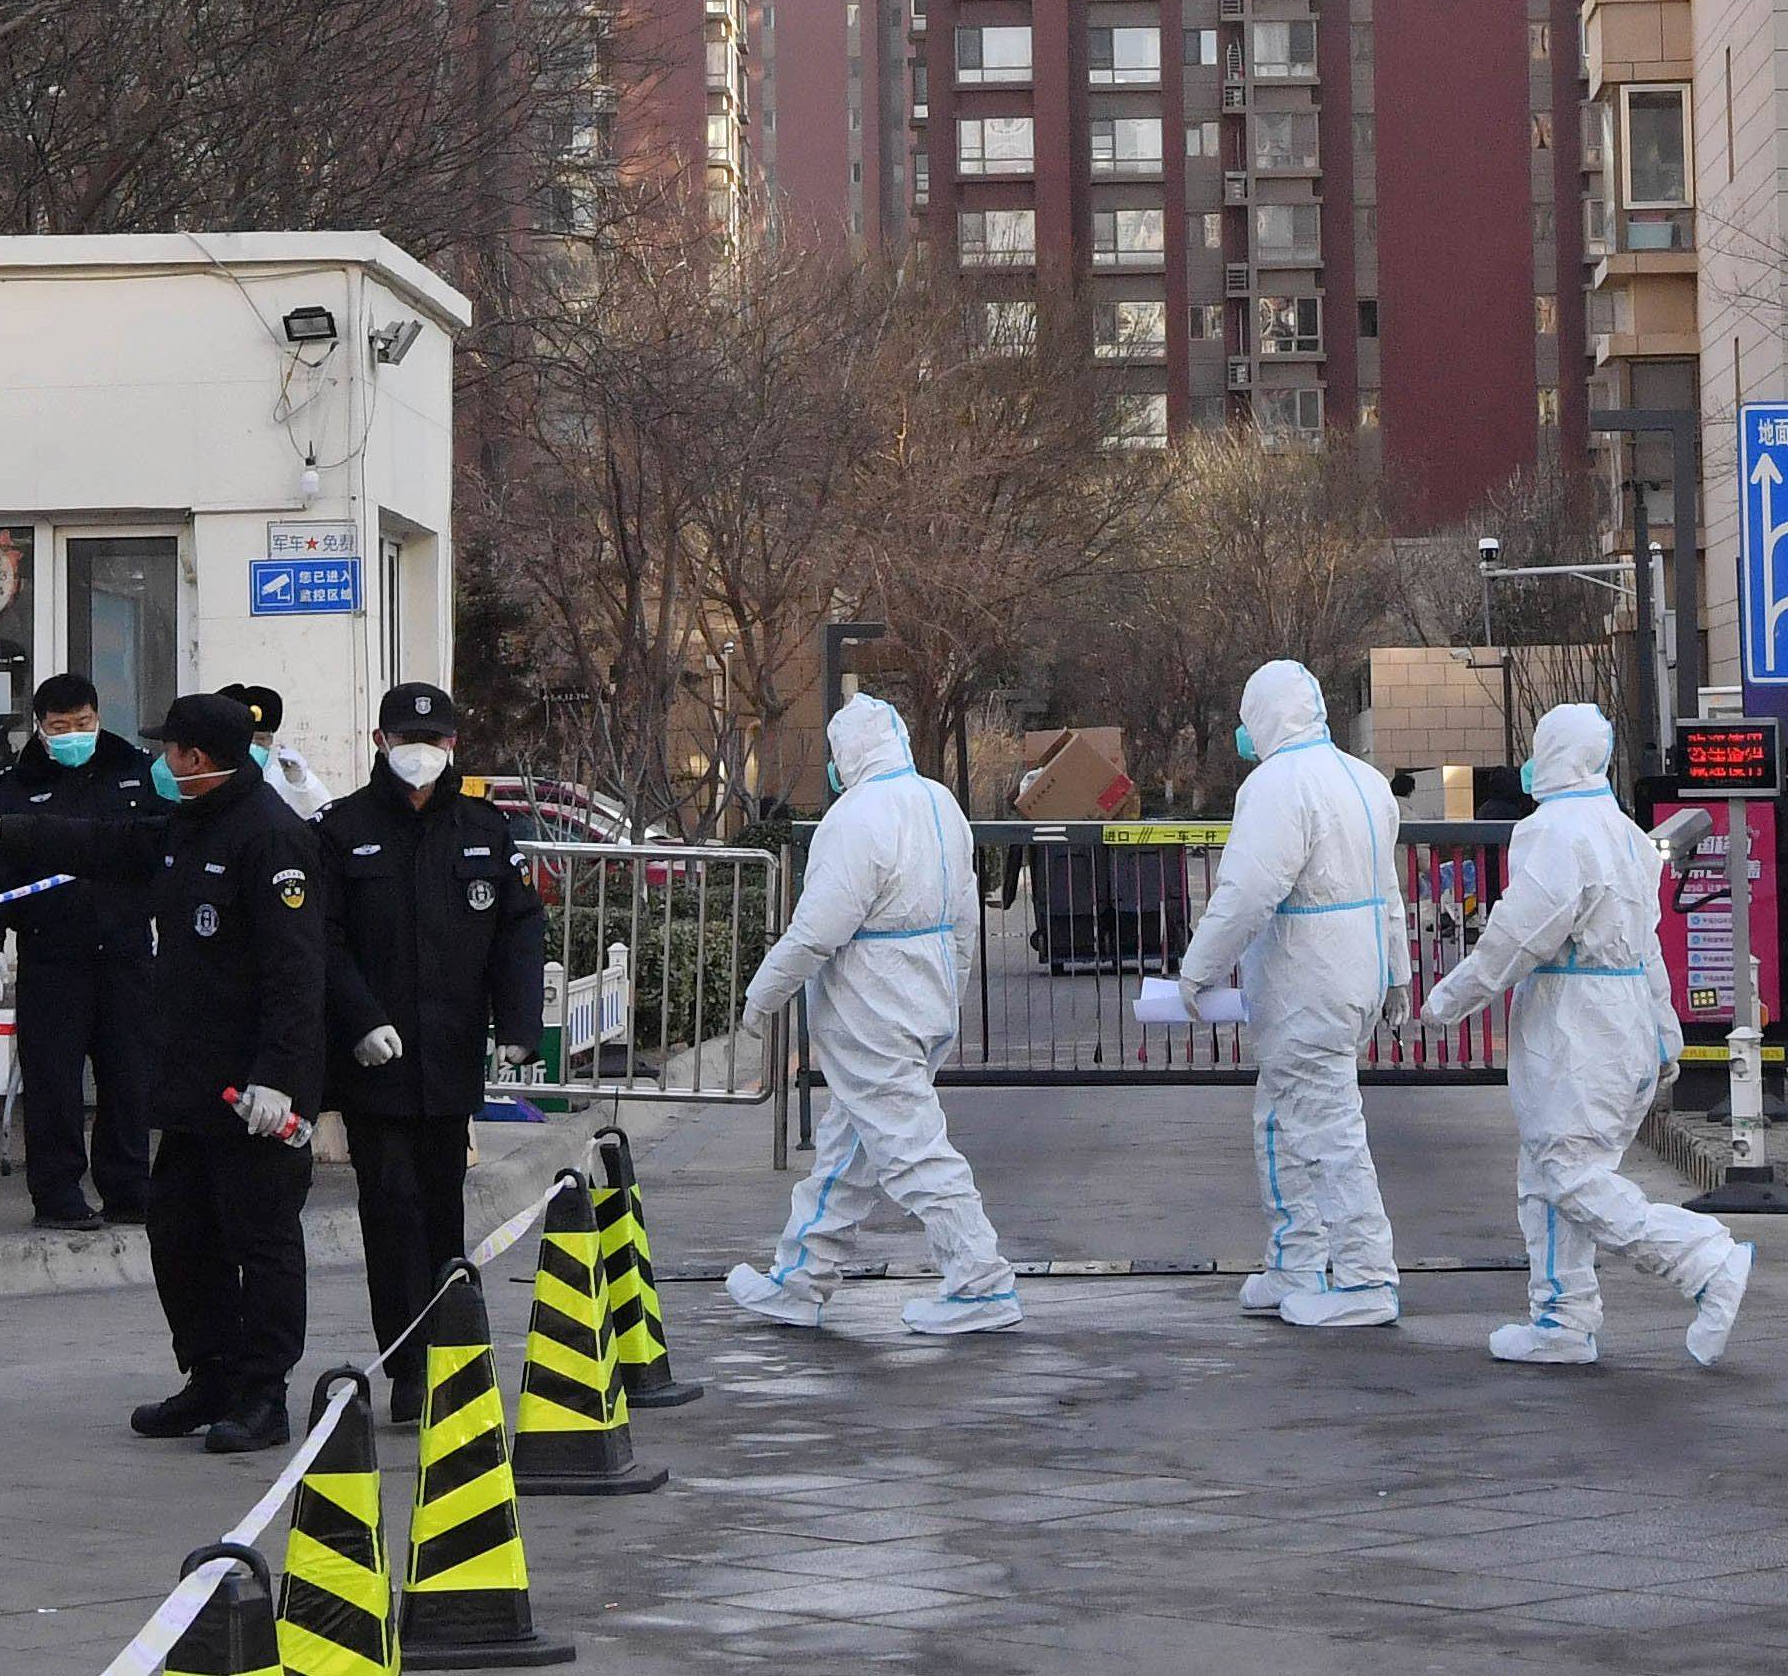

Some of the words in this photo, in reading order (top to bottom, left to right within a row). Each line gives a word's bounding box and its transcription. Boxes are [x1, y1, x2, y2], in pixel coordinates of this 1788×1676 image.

[272, 534, 304, 552] 军车
[299, 570, 350, 584] 您已进入
[300, 588, 352, 602] 监控区域
